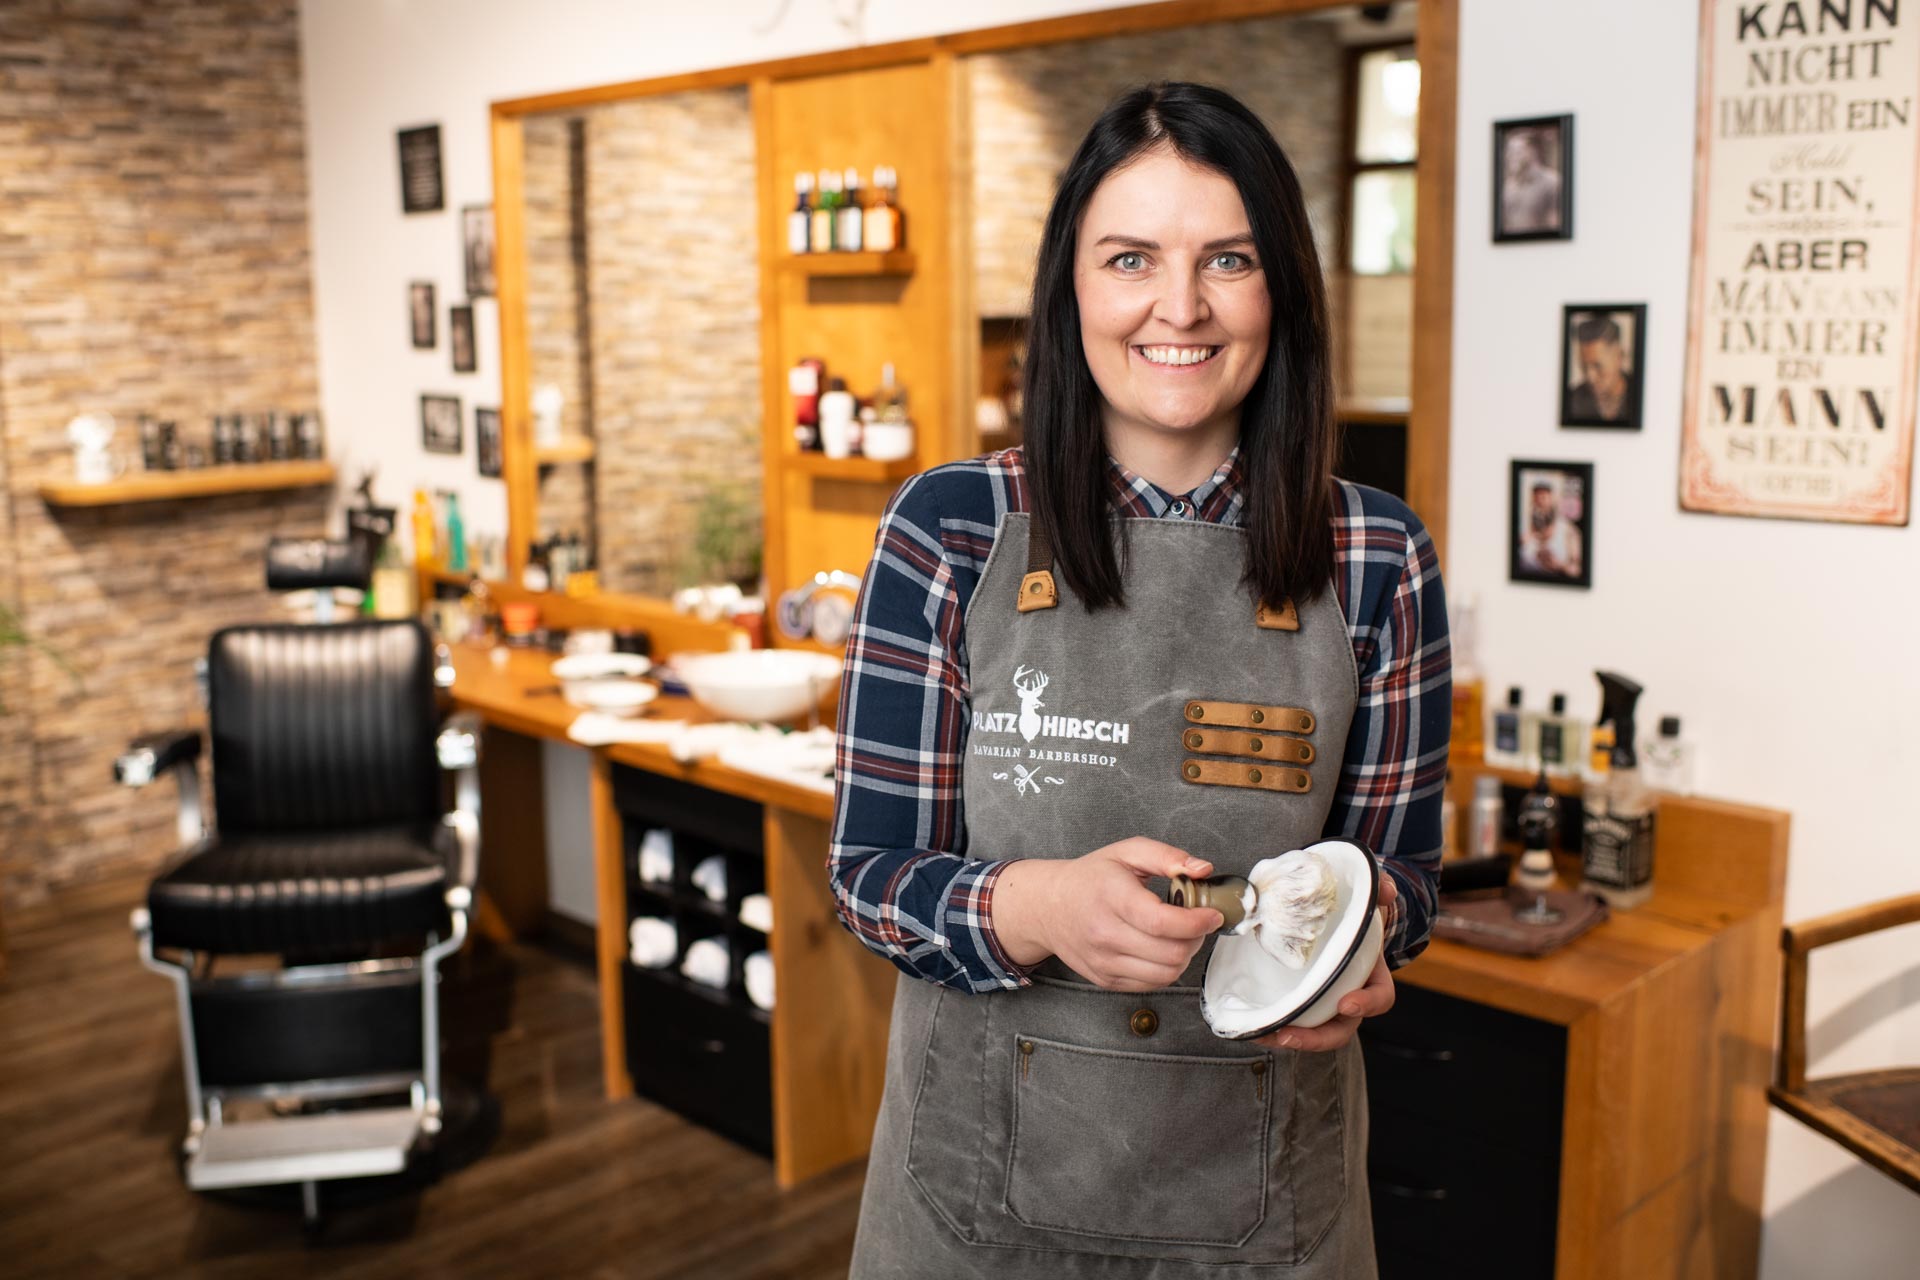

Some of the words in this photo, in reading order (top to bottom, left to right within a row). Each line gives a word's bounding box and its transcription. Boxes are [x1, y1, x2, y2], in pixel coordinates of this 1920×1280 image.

[1738, 0, 1898, 41] KANN
[1747, 39, 1893, 86] NICHT
[1720, 93, 1836, 138] IMMER
[1848, 97, 1911, 131] EIN
[1744, 240, 1868, 271] ABER
[1711, 276, 1811, 314] MAN
[1719, 319, 1887, 355] IMMER
[1776, 359, 1822, 380] EIN
[1708, 385, 1891, 430] MANN
[972, 711, 1018, 733] PLATZ
[1042, 715, 1130, 744] HIRSCH
[1029, 749, 1117, 767] BARBERSHOP
